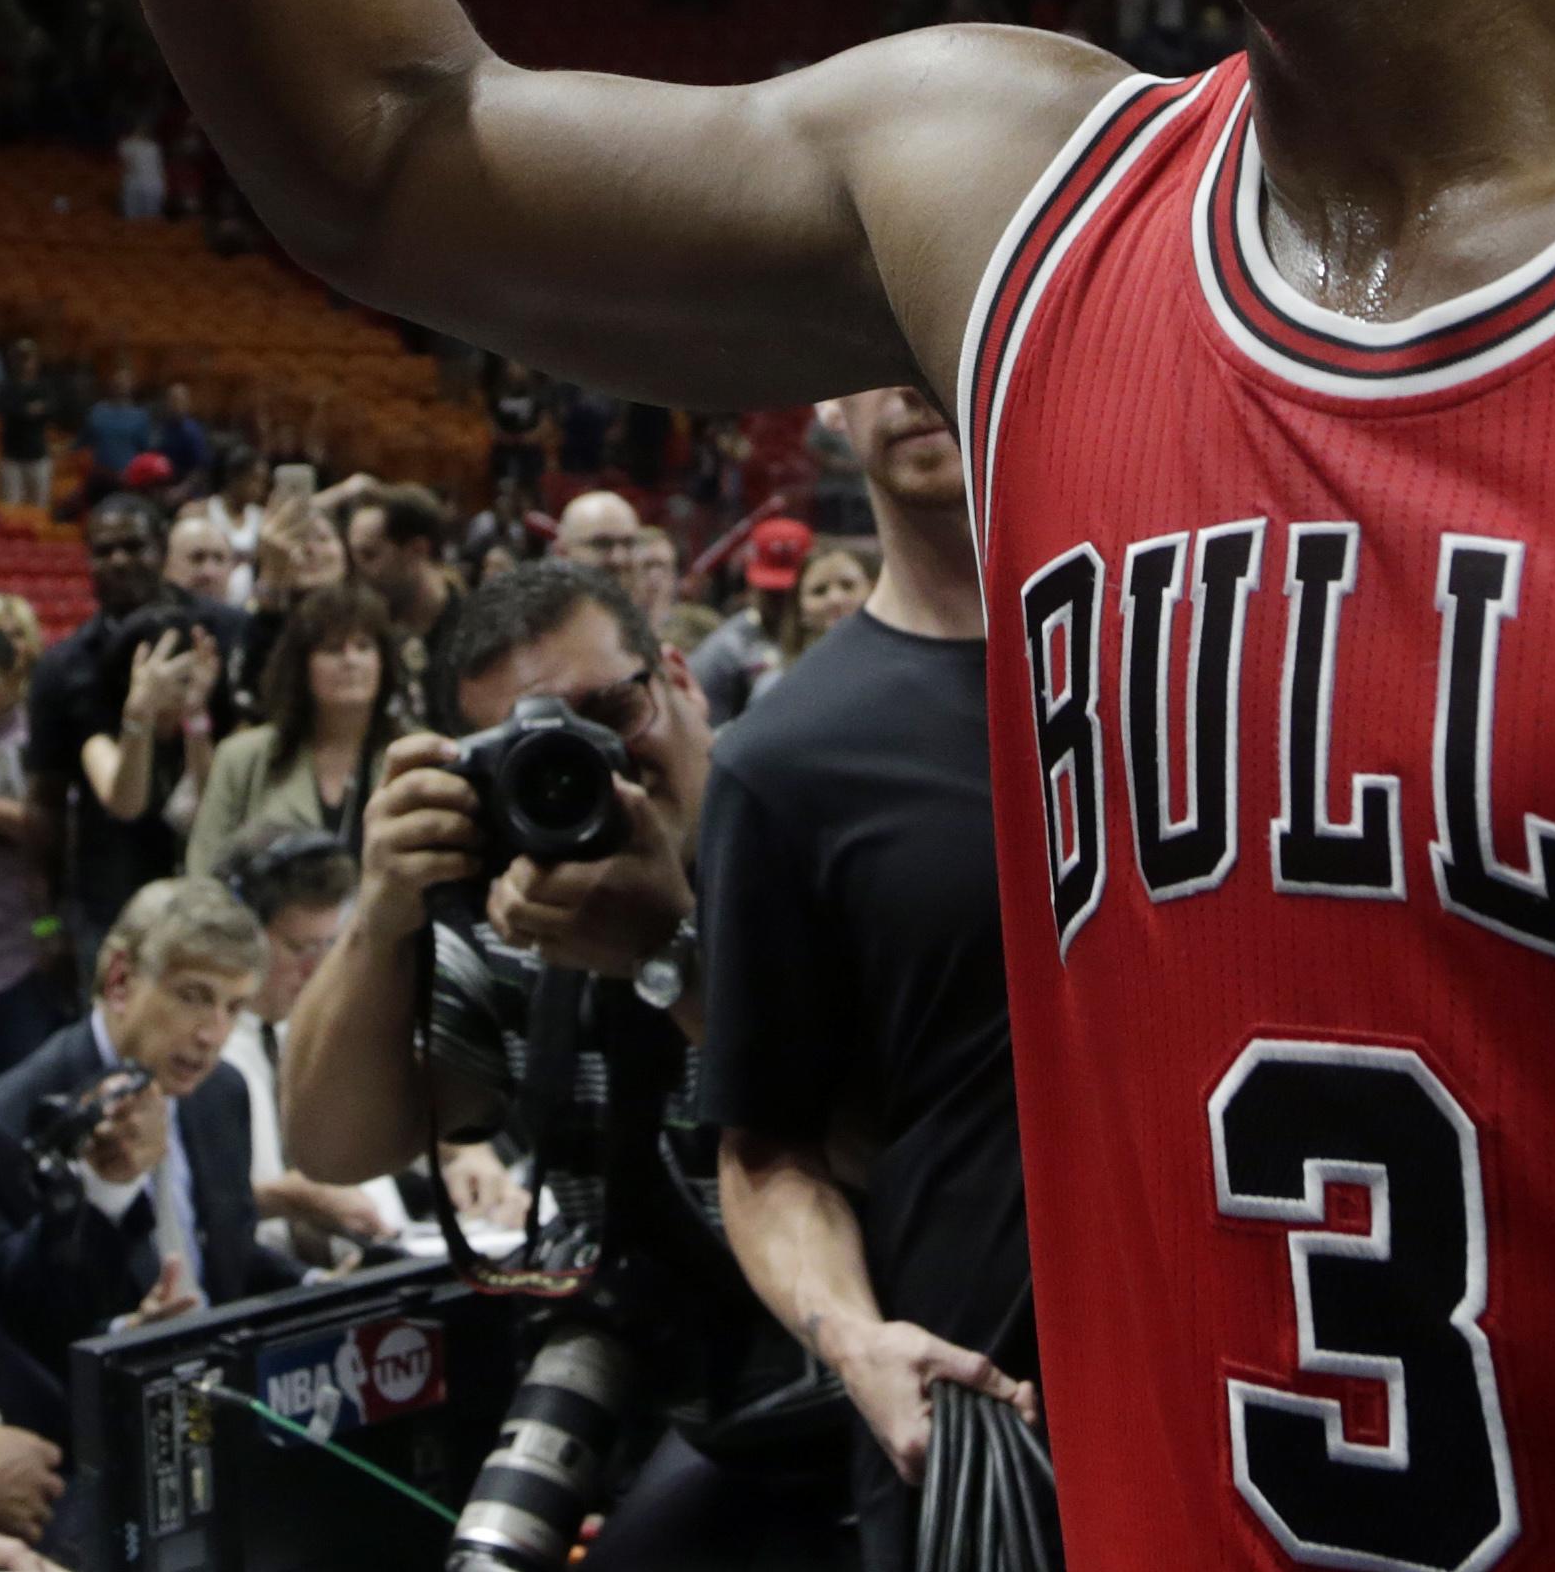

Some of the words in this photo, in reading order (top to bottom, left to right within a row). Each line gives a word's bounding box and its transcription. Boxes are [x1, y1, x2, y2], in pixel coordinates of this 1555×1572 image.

[265, 1361, 334, 1417] NBA
[373, 1345, 432, 1385] TNT
[1207, 1037, 1523, 1572] 3
